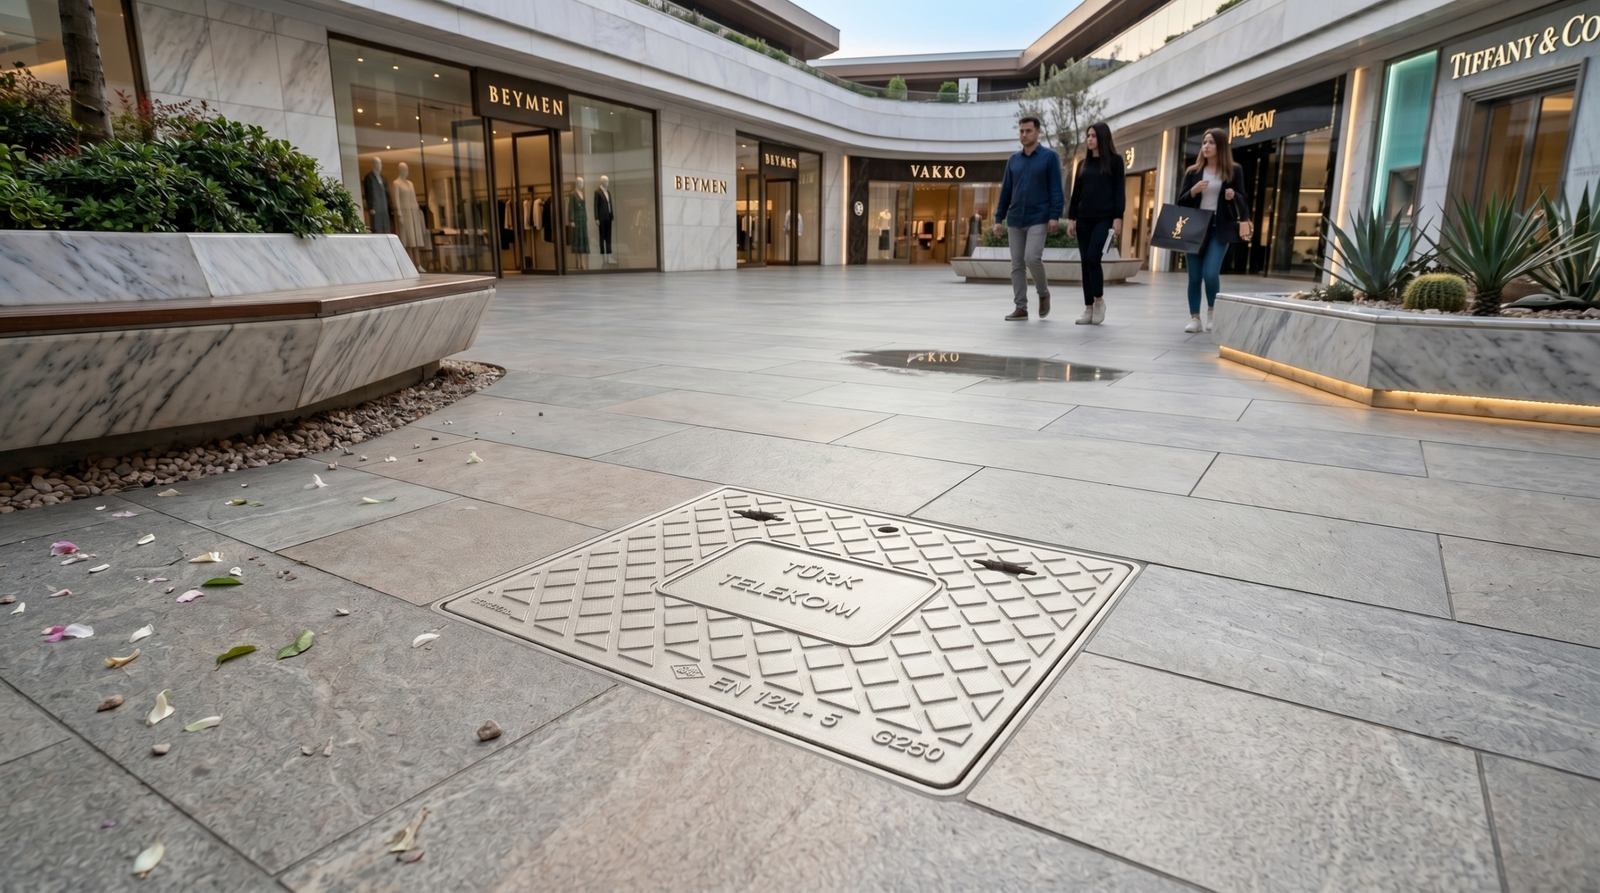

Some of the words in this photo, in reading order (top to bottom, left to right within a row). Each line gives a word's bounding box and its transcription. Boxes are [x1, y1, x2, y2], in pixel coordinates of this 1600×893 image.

[1450, 33, 1539, 79] TIFFANY
[1538, 26, 1560, 55] &
[488, 85, 564, 116] BEYMEN
[765, 153, 797, 169] BEYMEN
[910, 165, 966, 179] VAKKO
[674, 175, 727, 194] BEYMEN
[783, 562, 864, 590] TÜRK
[718, 573, 861, 619] TELEKOM
[709, 676, 752, 697] EN
[753, 690, 801, 714] 124
[819, 712, 844, 728] 5
[871, 730, 946, 763] G250
